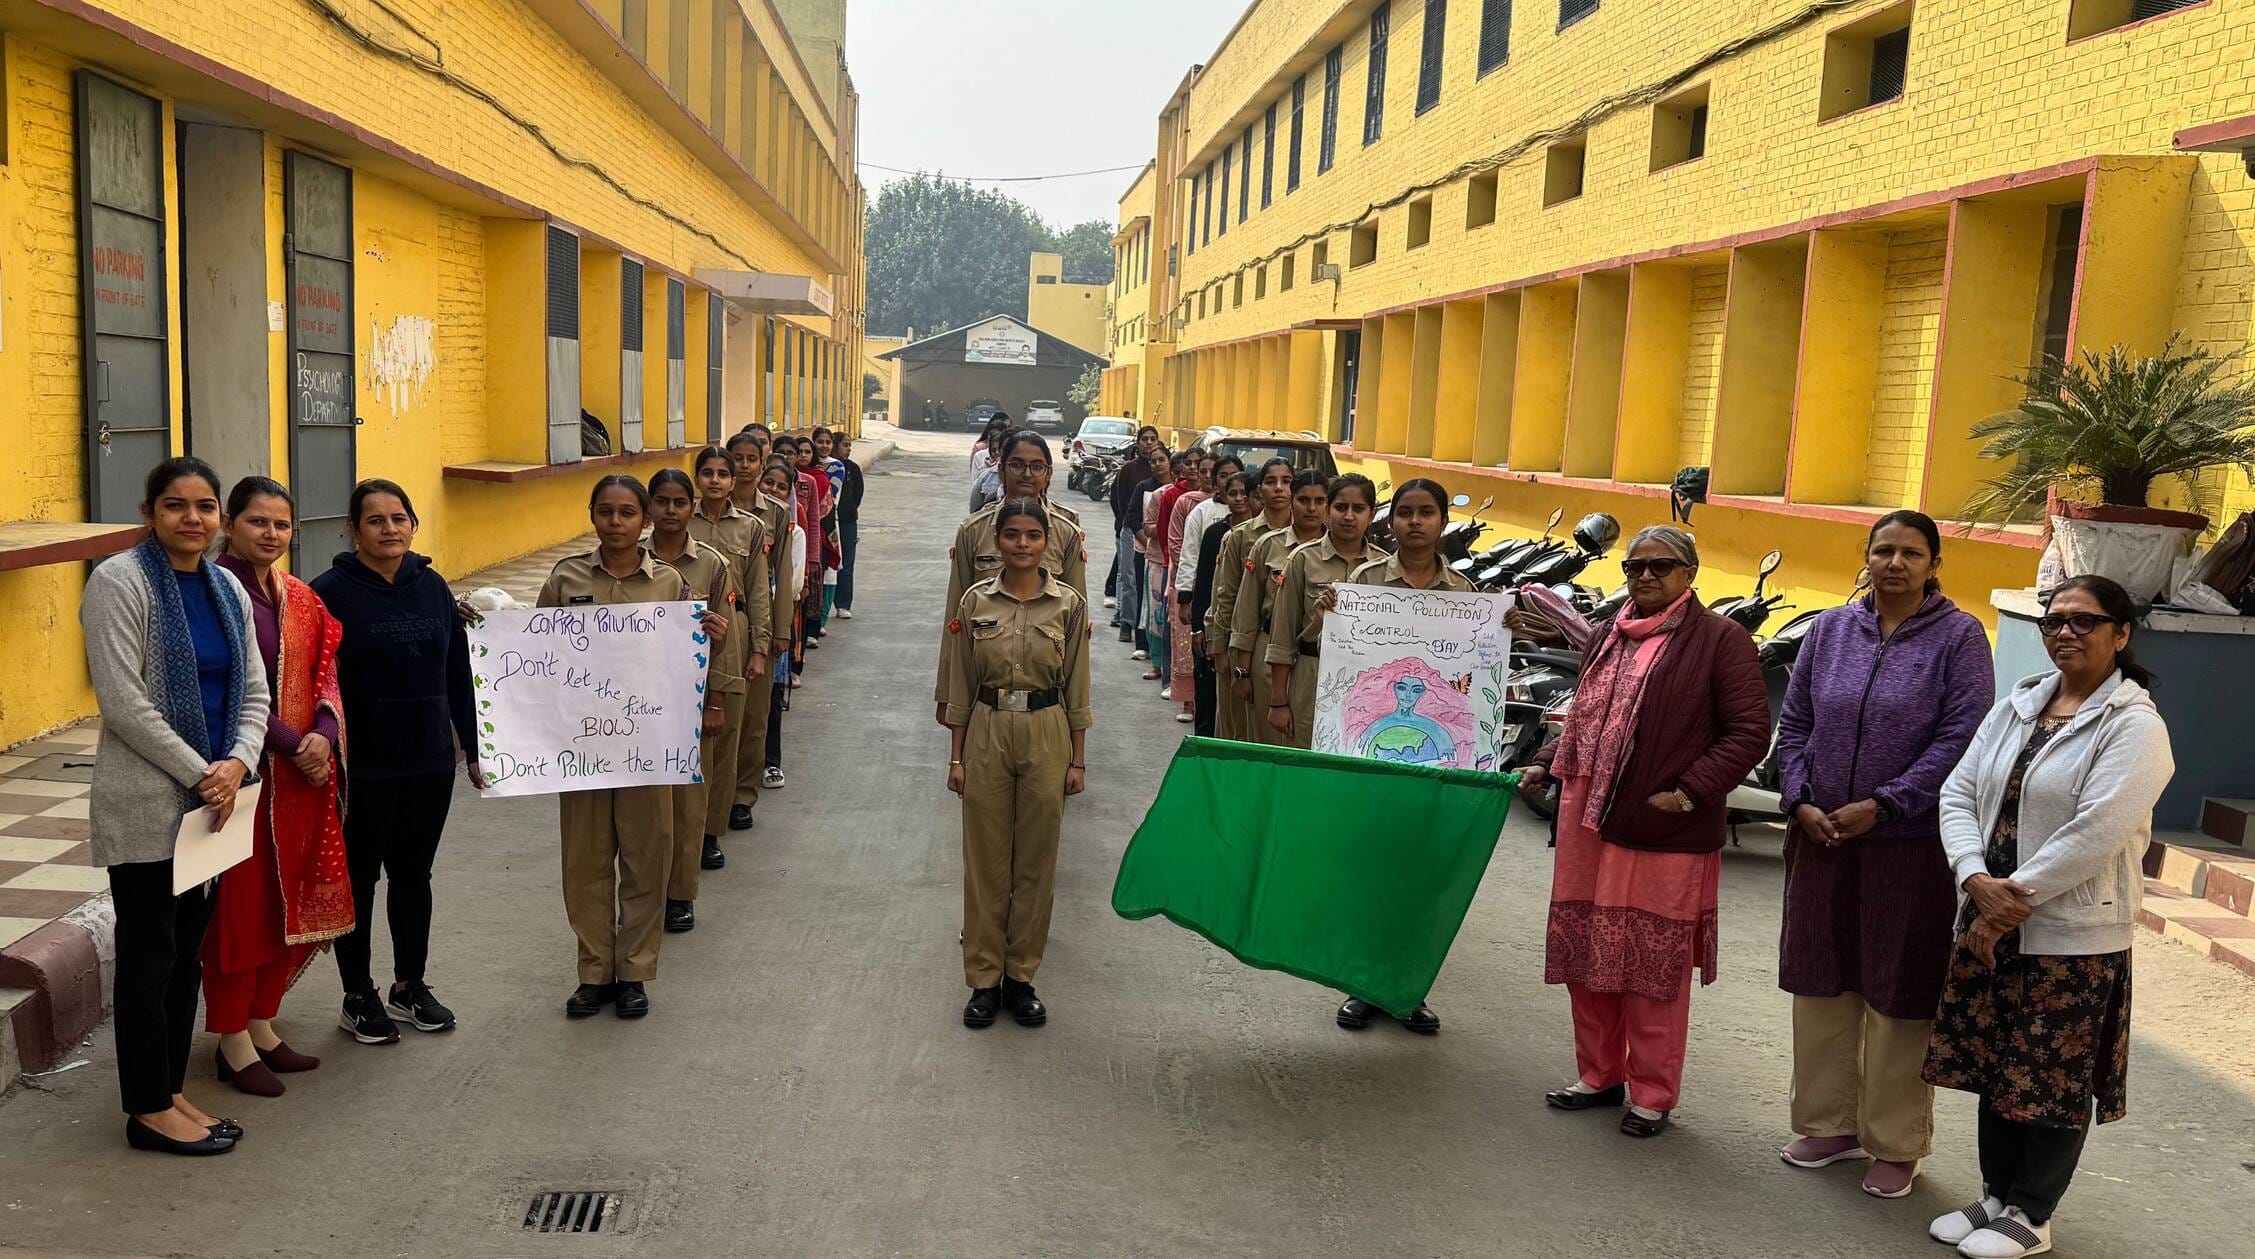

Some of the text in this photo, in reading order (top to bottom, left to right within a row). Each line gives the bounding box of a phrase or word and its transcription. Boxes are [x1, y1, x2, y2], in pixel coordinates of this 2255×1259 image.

[107, 247, 145, 281] PARKING
[308, 287, 342, 312] PARKING
[1339, 593, 1482, 620] NATIONAL POLLUTION
[1359, 622, 1420, 638] CONTROL
[1432, 638, 1459, 653] DAY
[494, 650, 592, 691] Don't let
[594, 678, 622, 700] the
[622, 695, 664, 717] future
[493, 752, 549, 785] Don't
[557, 749, 614, 779] Pollute
[622, 746, 656, 773] the
